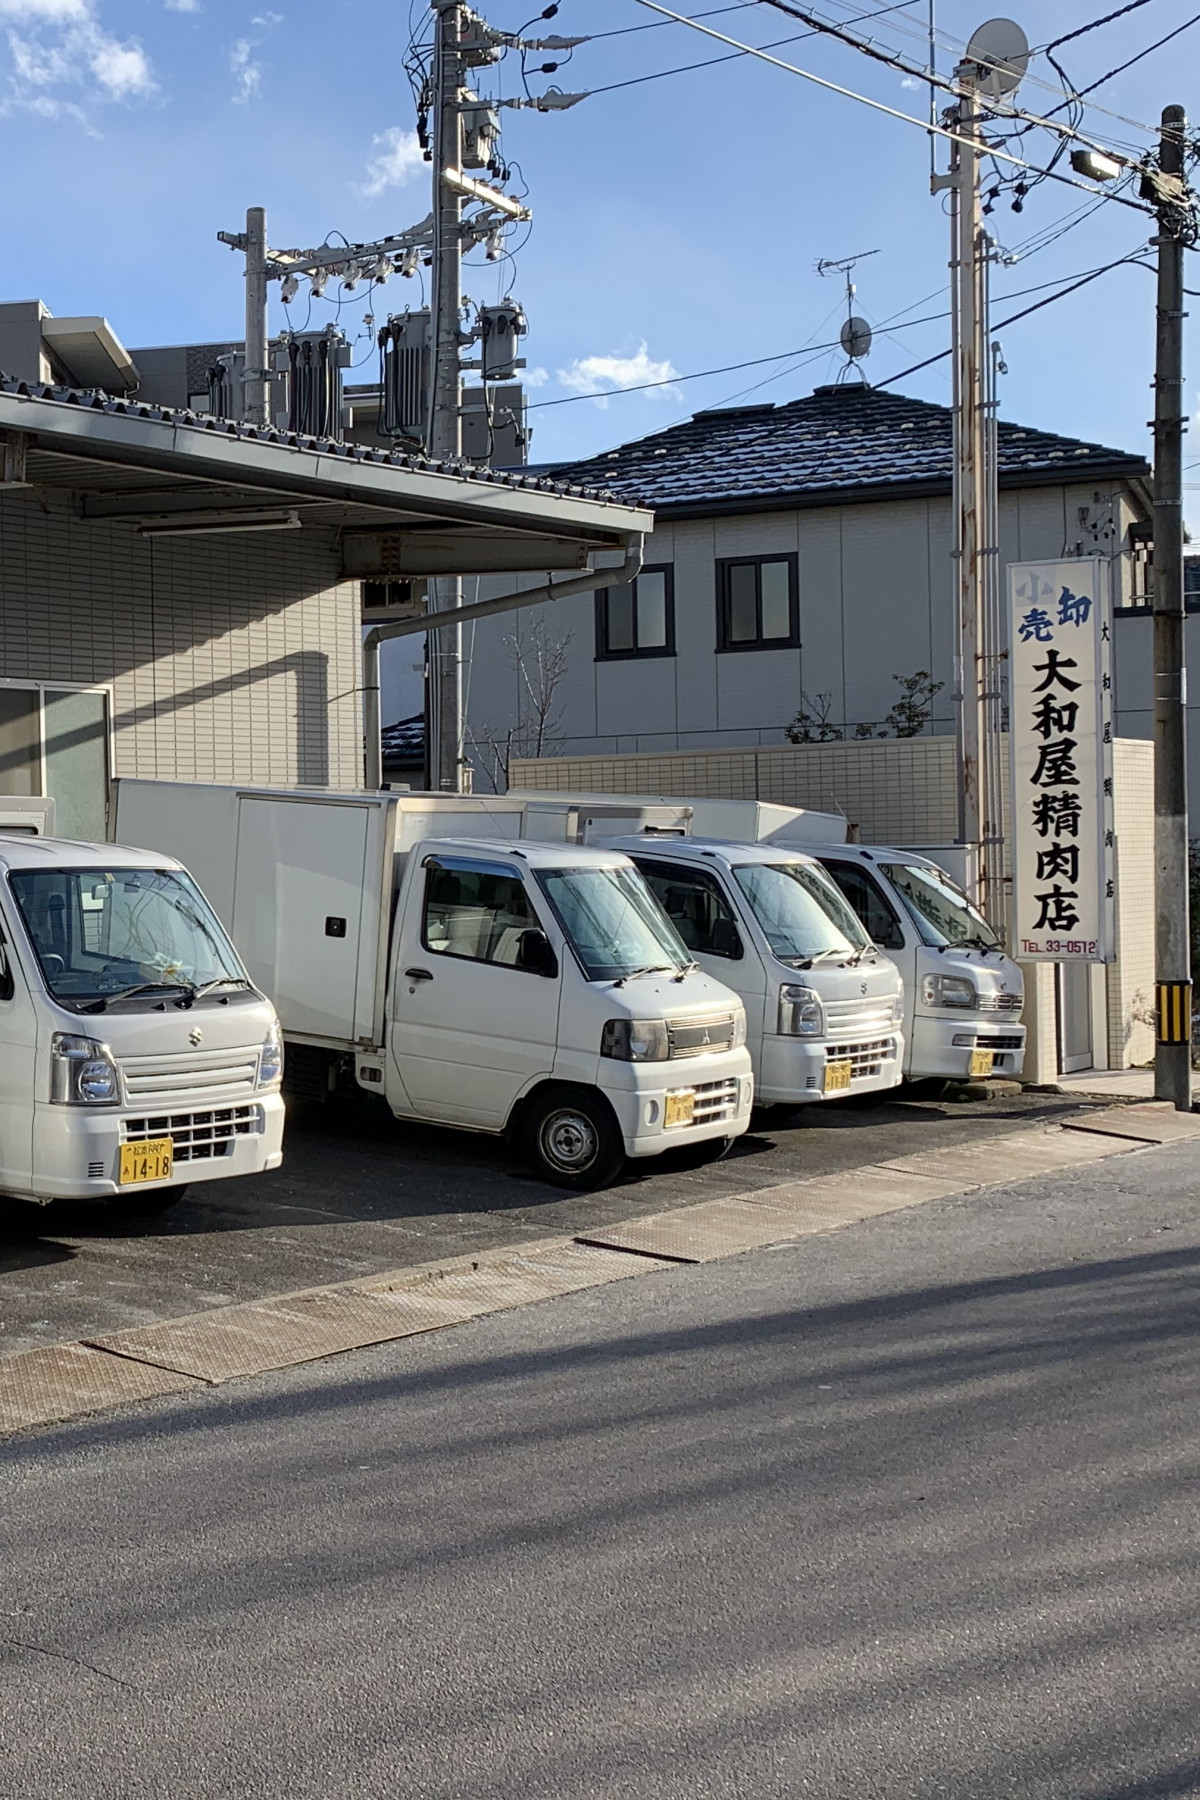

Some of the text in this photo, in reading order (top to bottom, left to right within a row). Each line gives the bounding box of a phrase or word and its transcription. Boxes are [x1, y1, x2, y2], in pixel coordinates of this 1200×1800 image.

[1056, 585, 1093, 628] 卸
[1101, 621, 1114, 899] 大和屋精肉店
[1030, 648, 1083, 932] 大和屋精肉店
[1046, 941, 1096, 954] 33-0512
[133, 1156, 170, 1179] 14-18
